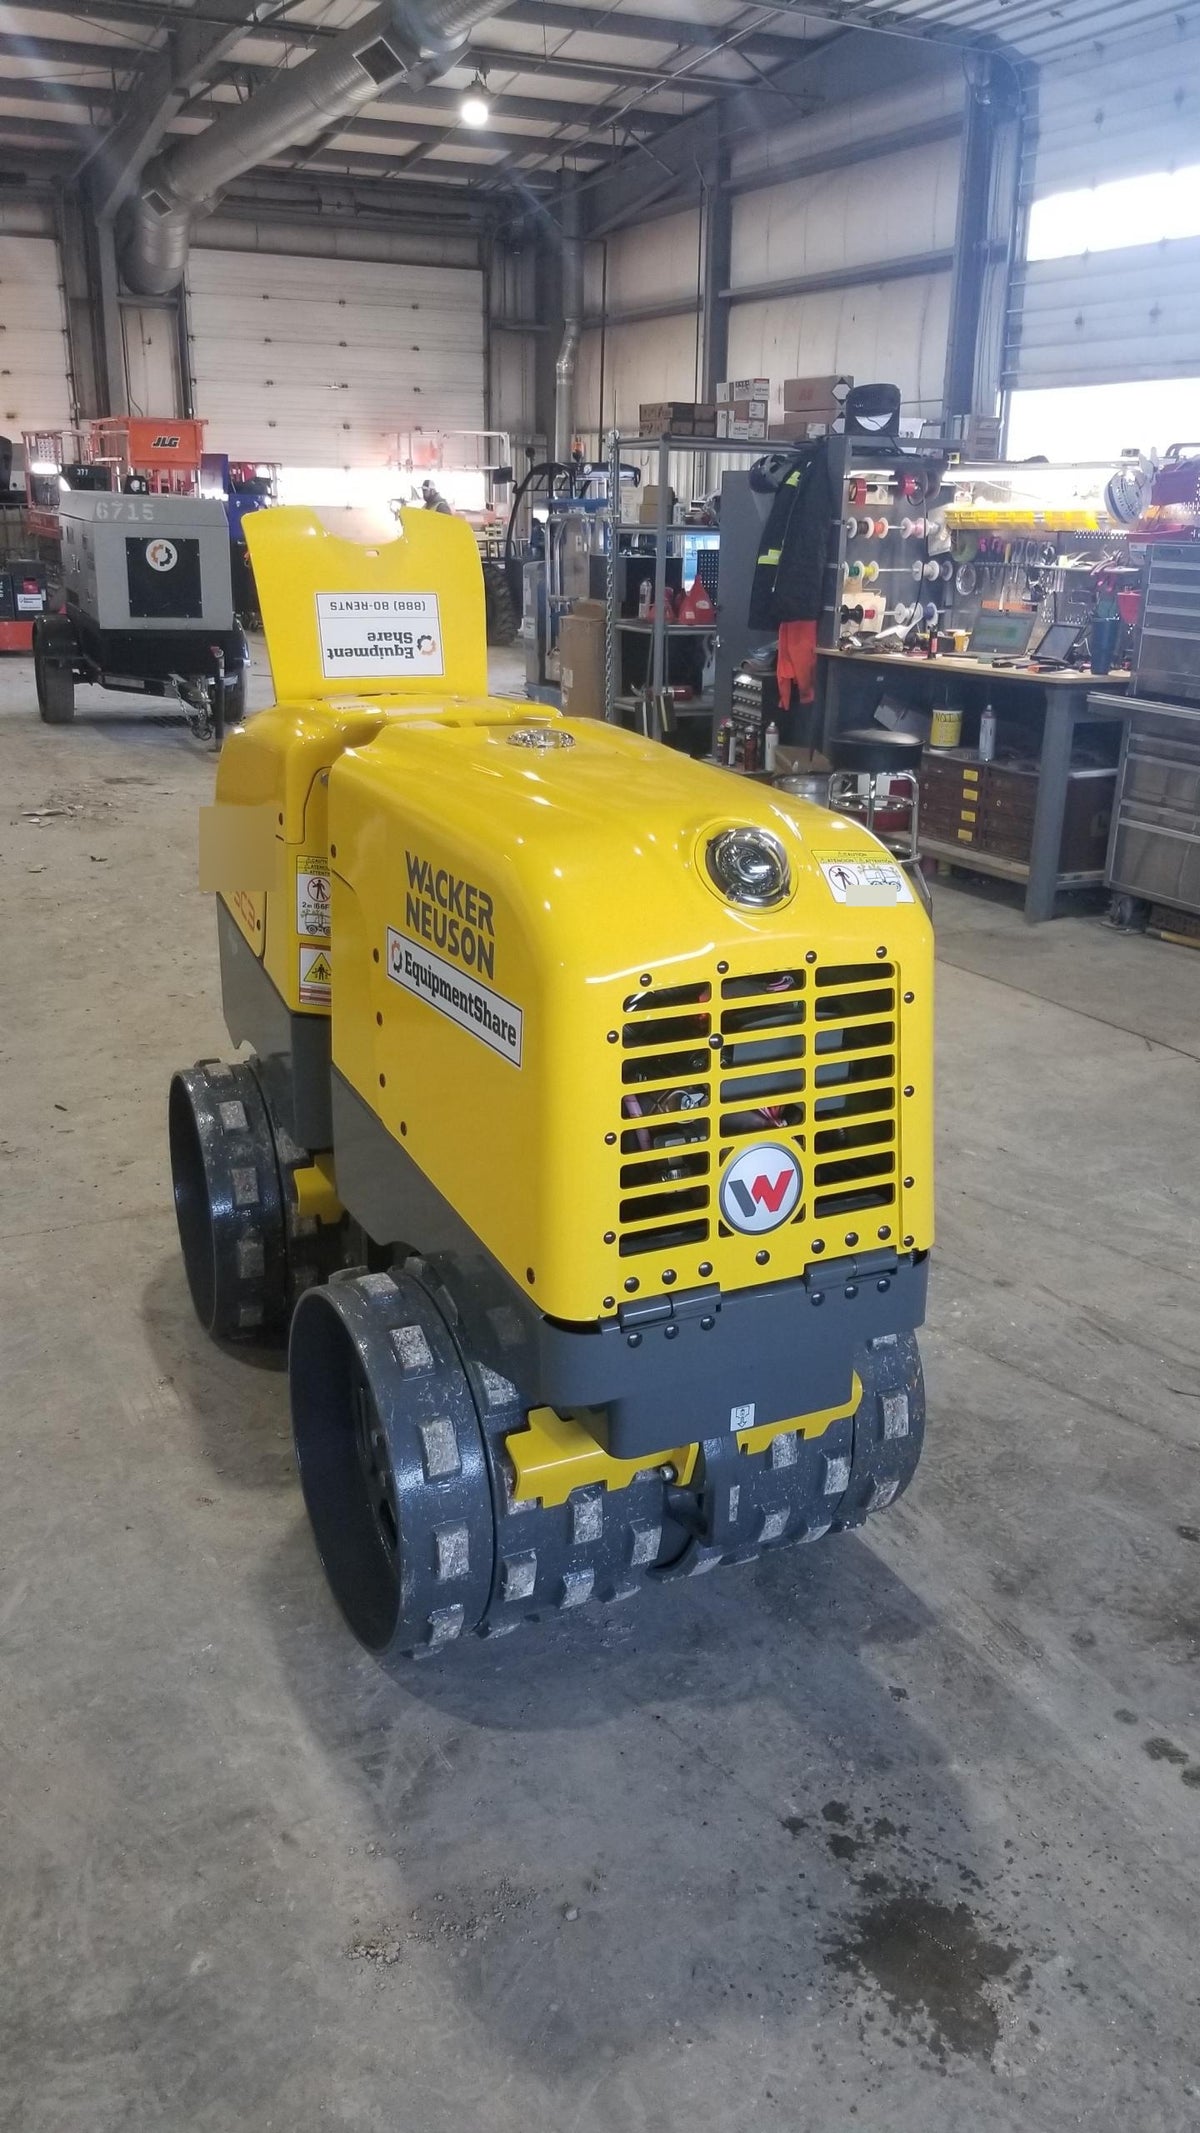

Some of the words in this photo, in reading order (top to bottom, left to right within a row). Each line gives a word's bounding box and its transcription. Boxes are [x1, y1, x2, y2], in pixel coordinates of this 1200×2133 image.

[152, 436, 180, 448] JLG
[96, 501, 154, 520] 6715
[330, 601, 389, 611] 80-RENTS
[393, 600, 426, 611] (888)
[367, 632, 413, 644] Share
[327, 645, 415, 660] Equipment
[405, 850, 495, 937] WACKER
[406, 891, 494, 981] NEUSON
[404, 950, 517, 1048] EquipmentShare
